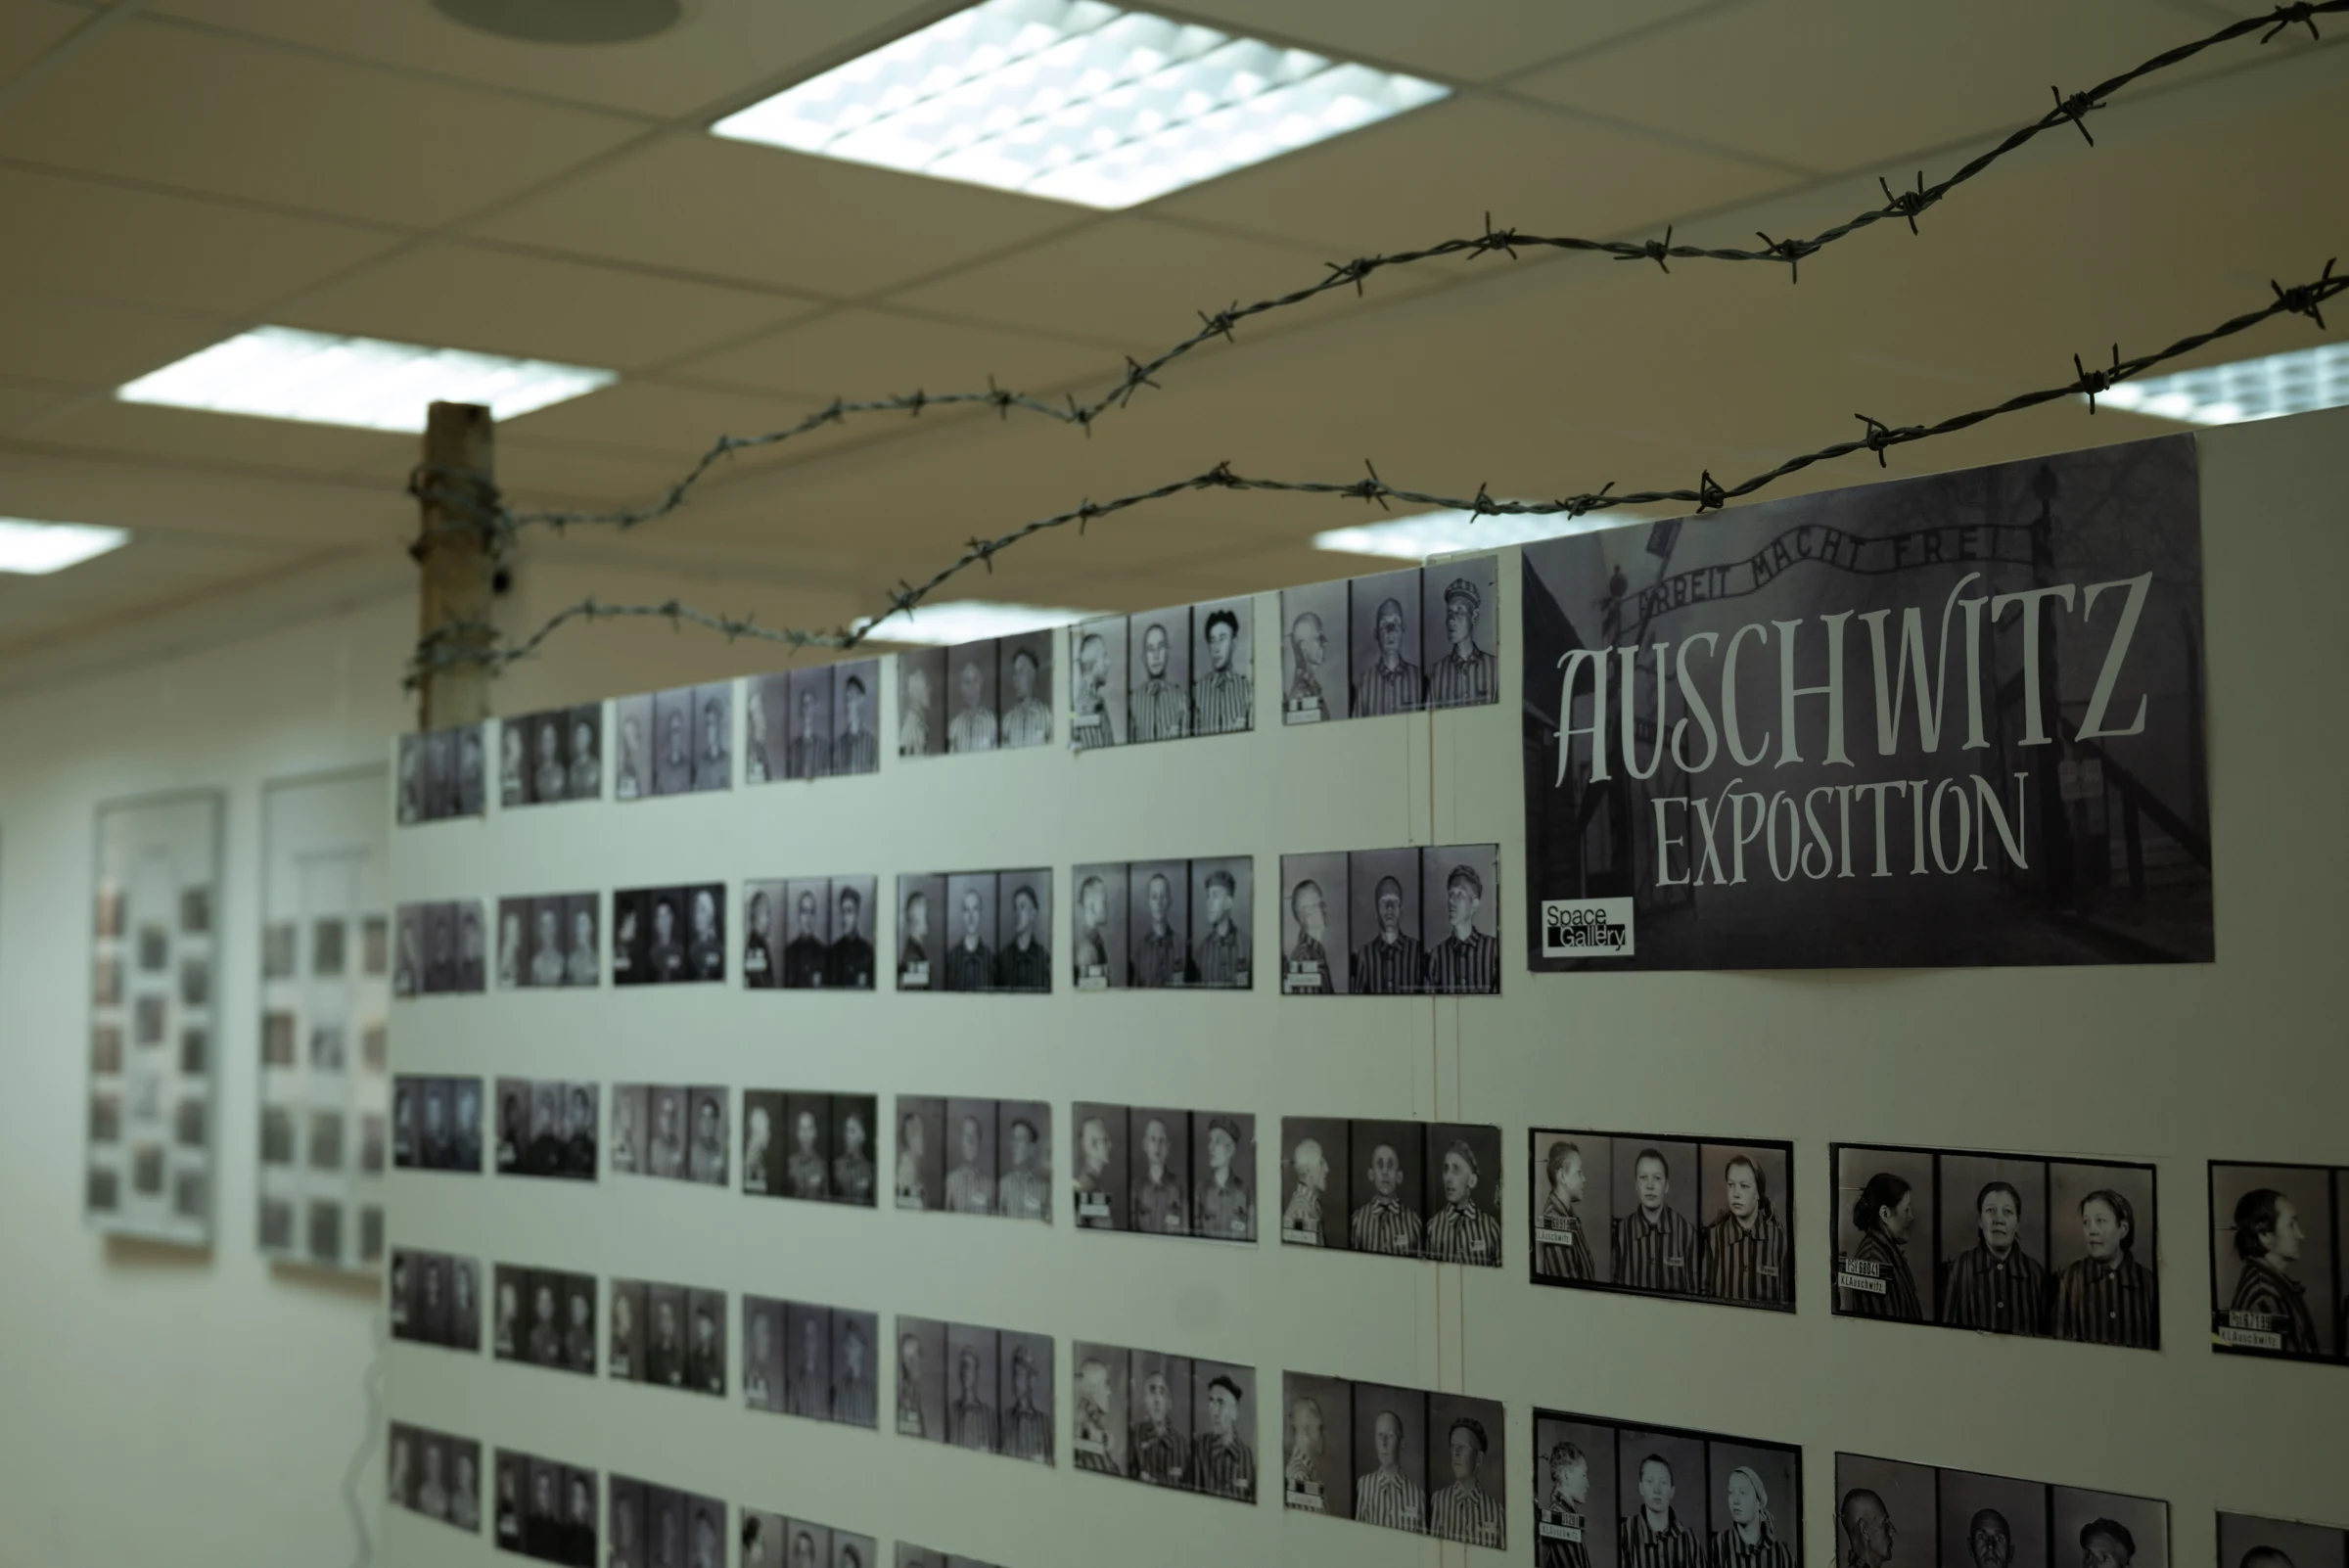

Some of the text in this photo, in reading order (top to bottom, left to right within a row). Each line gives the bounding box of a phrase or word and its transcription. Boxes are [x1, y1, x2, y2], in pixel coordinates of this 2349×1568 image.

[1636, 528, 1998, 620] ARBEIT MACHT FREI
[1553, 571, 2153, 788] AUSCHWITZ
[1651, 771, 2029, 888] EXPOSITION
[1546, 904, 1607, 927] Space
[1560, 924, 1626, 952] Gallery
